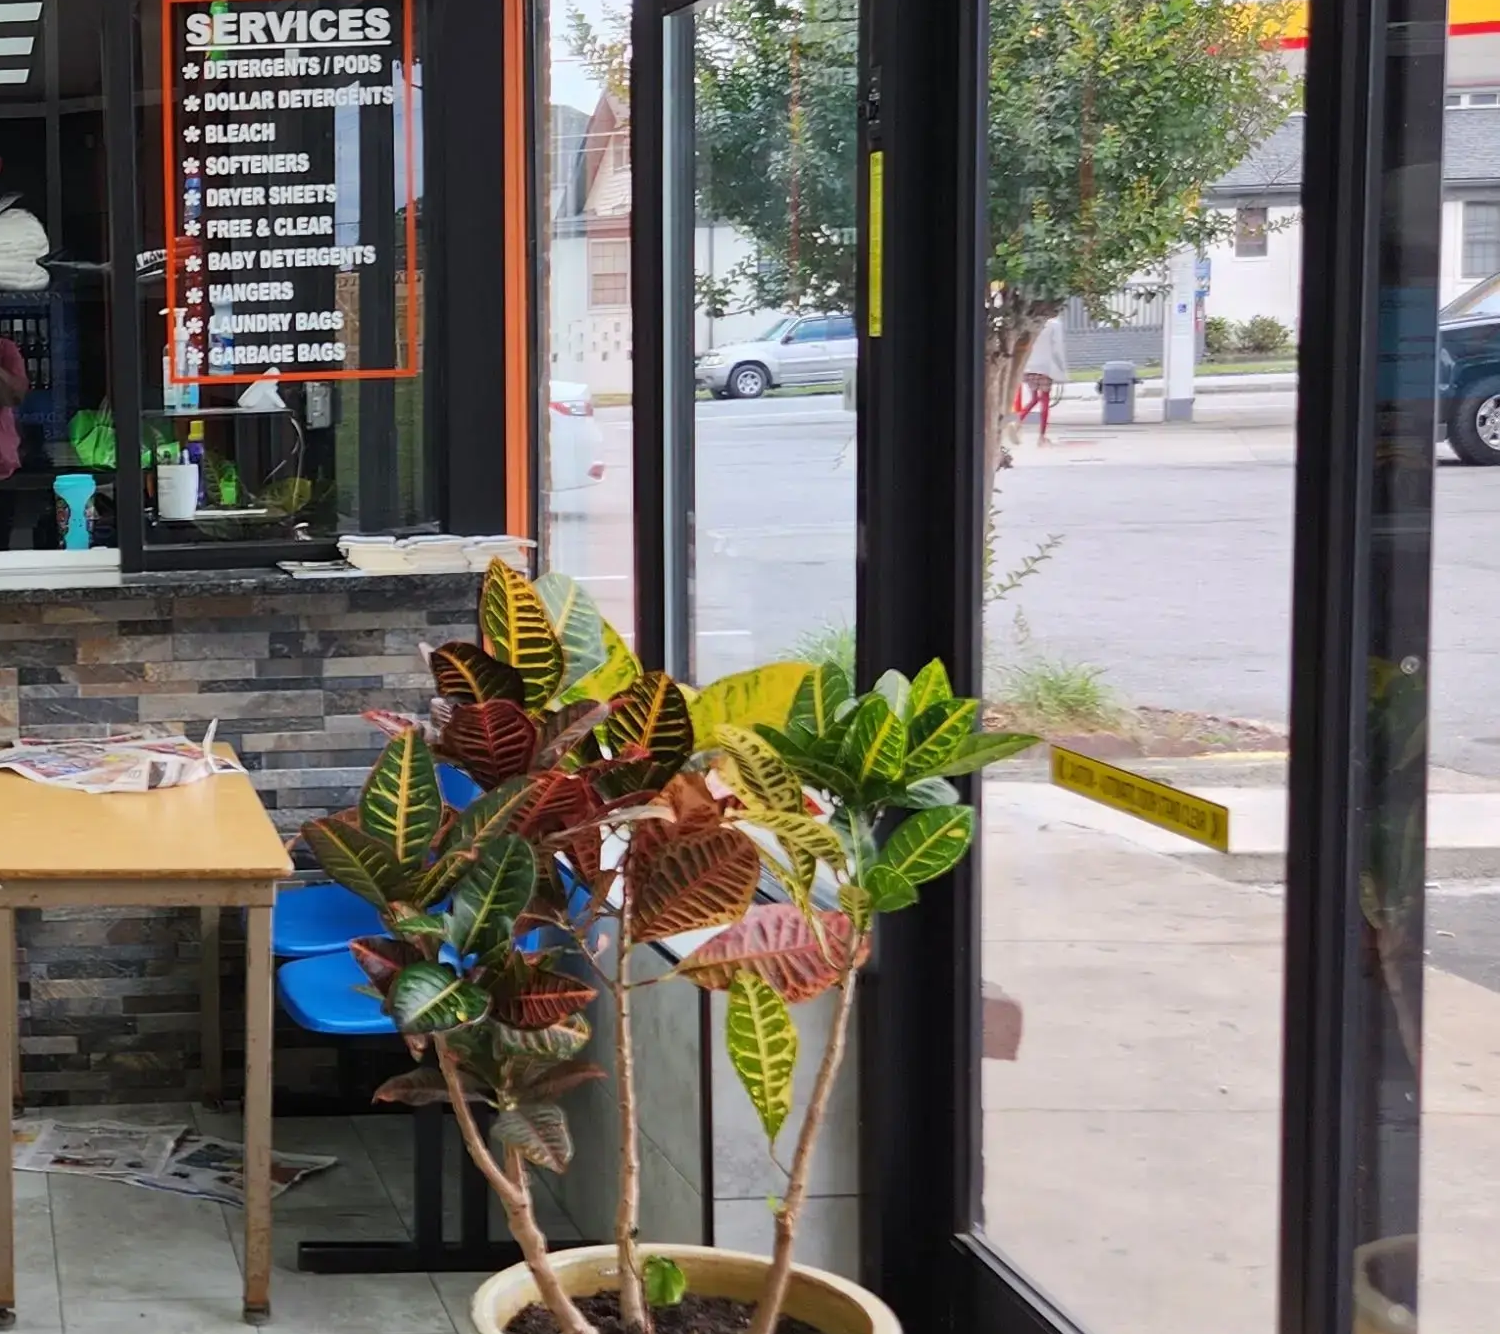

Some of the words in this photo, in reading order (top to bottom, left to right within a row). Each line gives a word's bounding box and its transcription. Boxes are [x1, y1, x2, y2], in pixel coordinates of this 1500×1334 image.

[185, 8, 391, 45] SERVICES
[203, 56, 321, 79] DETERGENTS
[333, 54, 382, 74] PODS
[204, 91, 275, 111] DOLLAR
[277, 85, 394, 109] DETERGENTS
[205, 122, 276, 143] BLEACH
[205, 153, 310, 176] SOFTENERS
[206, 187, 266, 207] DRYER
[268, 184, 337, 205] SHEETS
[206, 218, 253, 239] FREE
[256, 218, 271, 237] &
[274, 216, 333, 236] CLEAR
[208, 250, 257, 270] BABY
[259, 245, 376, 269] DETERGENTS
[208, 281, 294, 302] HANGERS
[208, 313, 293, 334] LAUNDRY
[295, 311, 344, 332] BAGS
[208, 344, 297, 366] GARBAGE
[297, 342, 346, 362] BAGS
